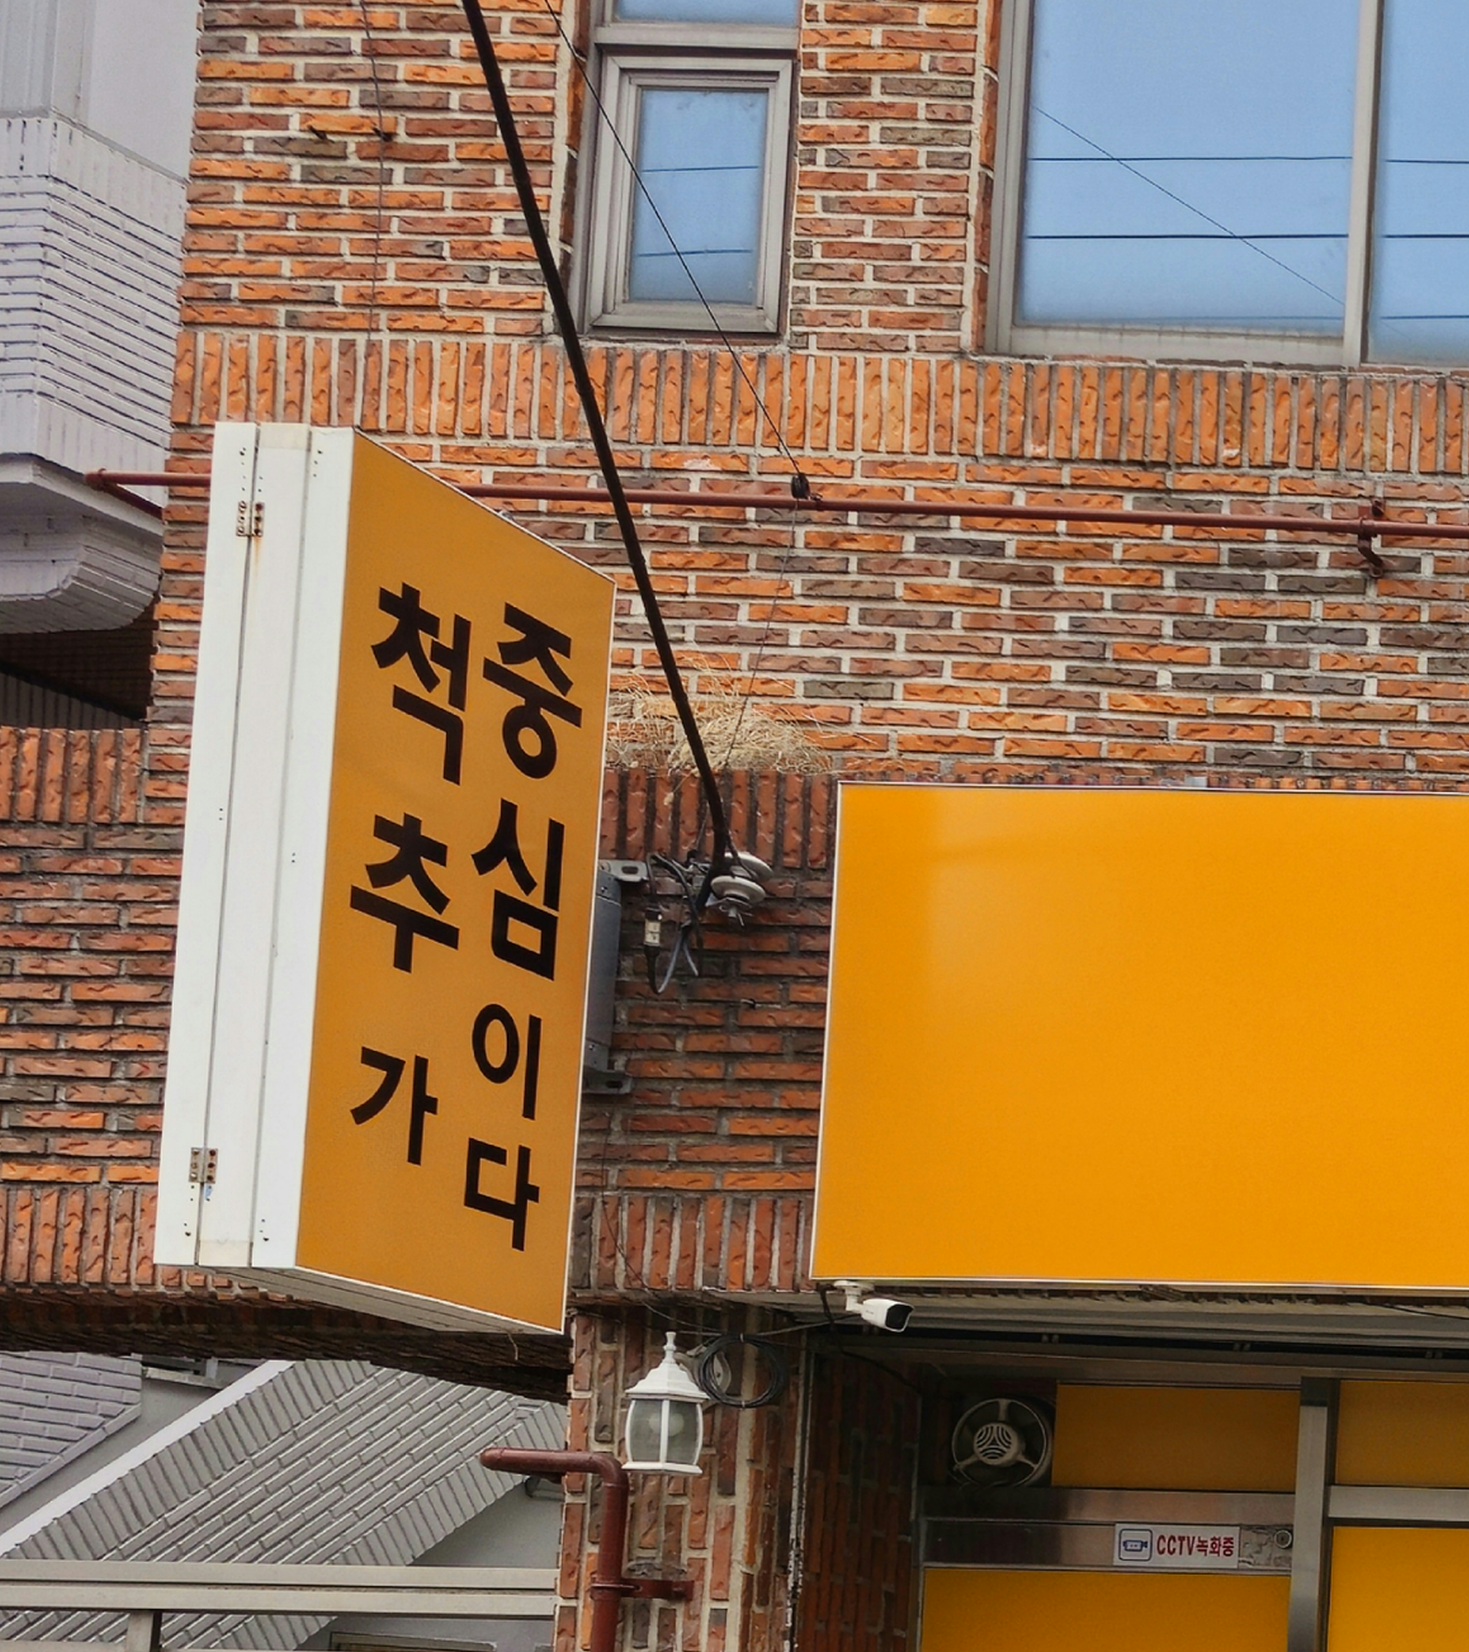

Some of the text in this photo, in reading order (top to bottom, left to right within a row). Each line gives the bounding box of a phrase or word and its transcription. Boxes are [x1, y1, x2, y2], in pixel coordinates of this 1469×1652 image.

[350, 583, 472, 1164] 척추가
[463, 602, 582, 1251] 중심이다
[1157, 1535, 1234, 1557] CCTV녹화중
